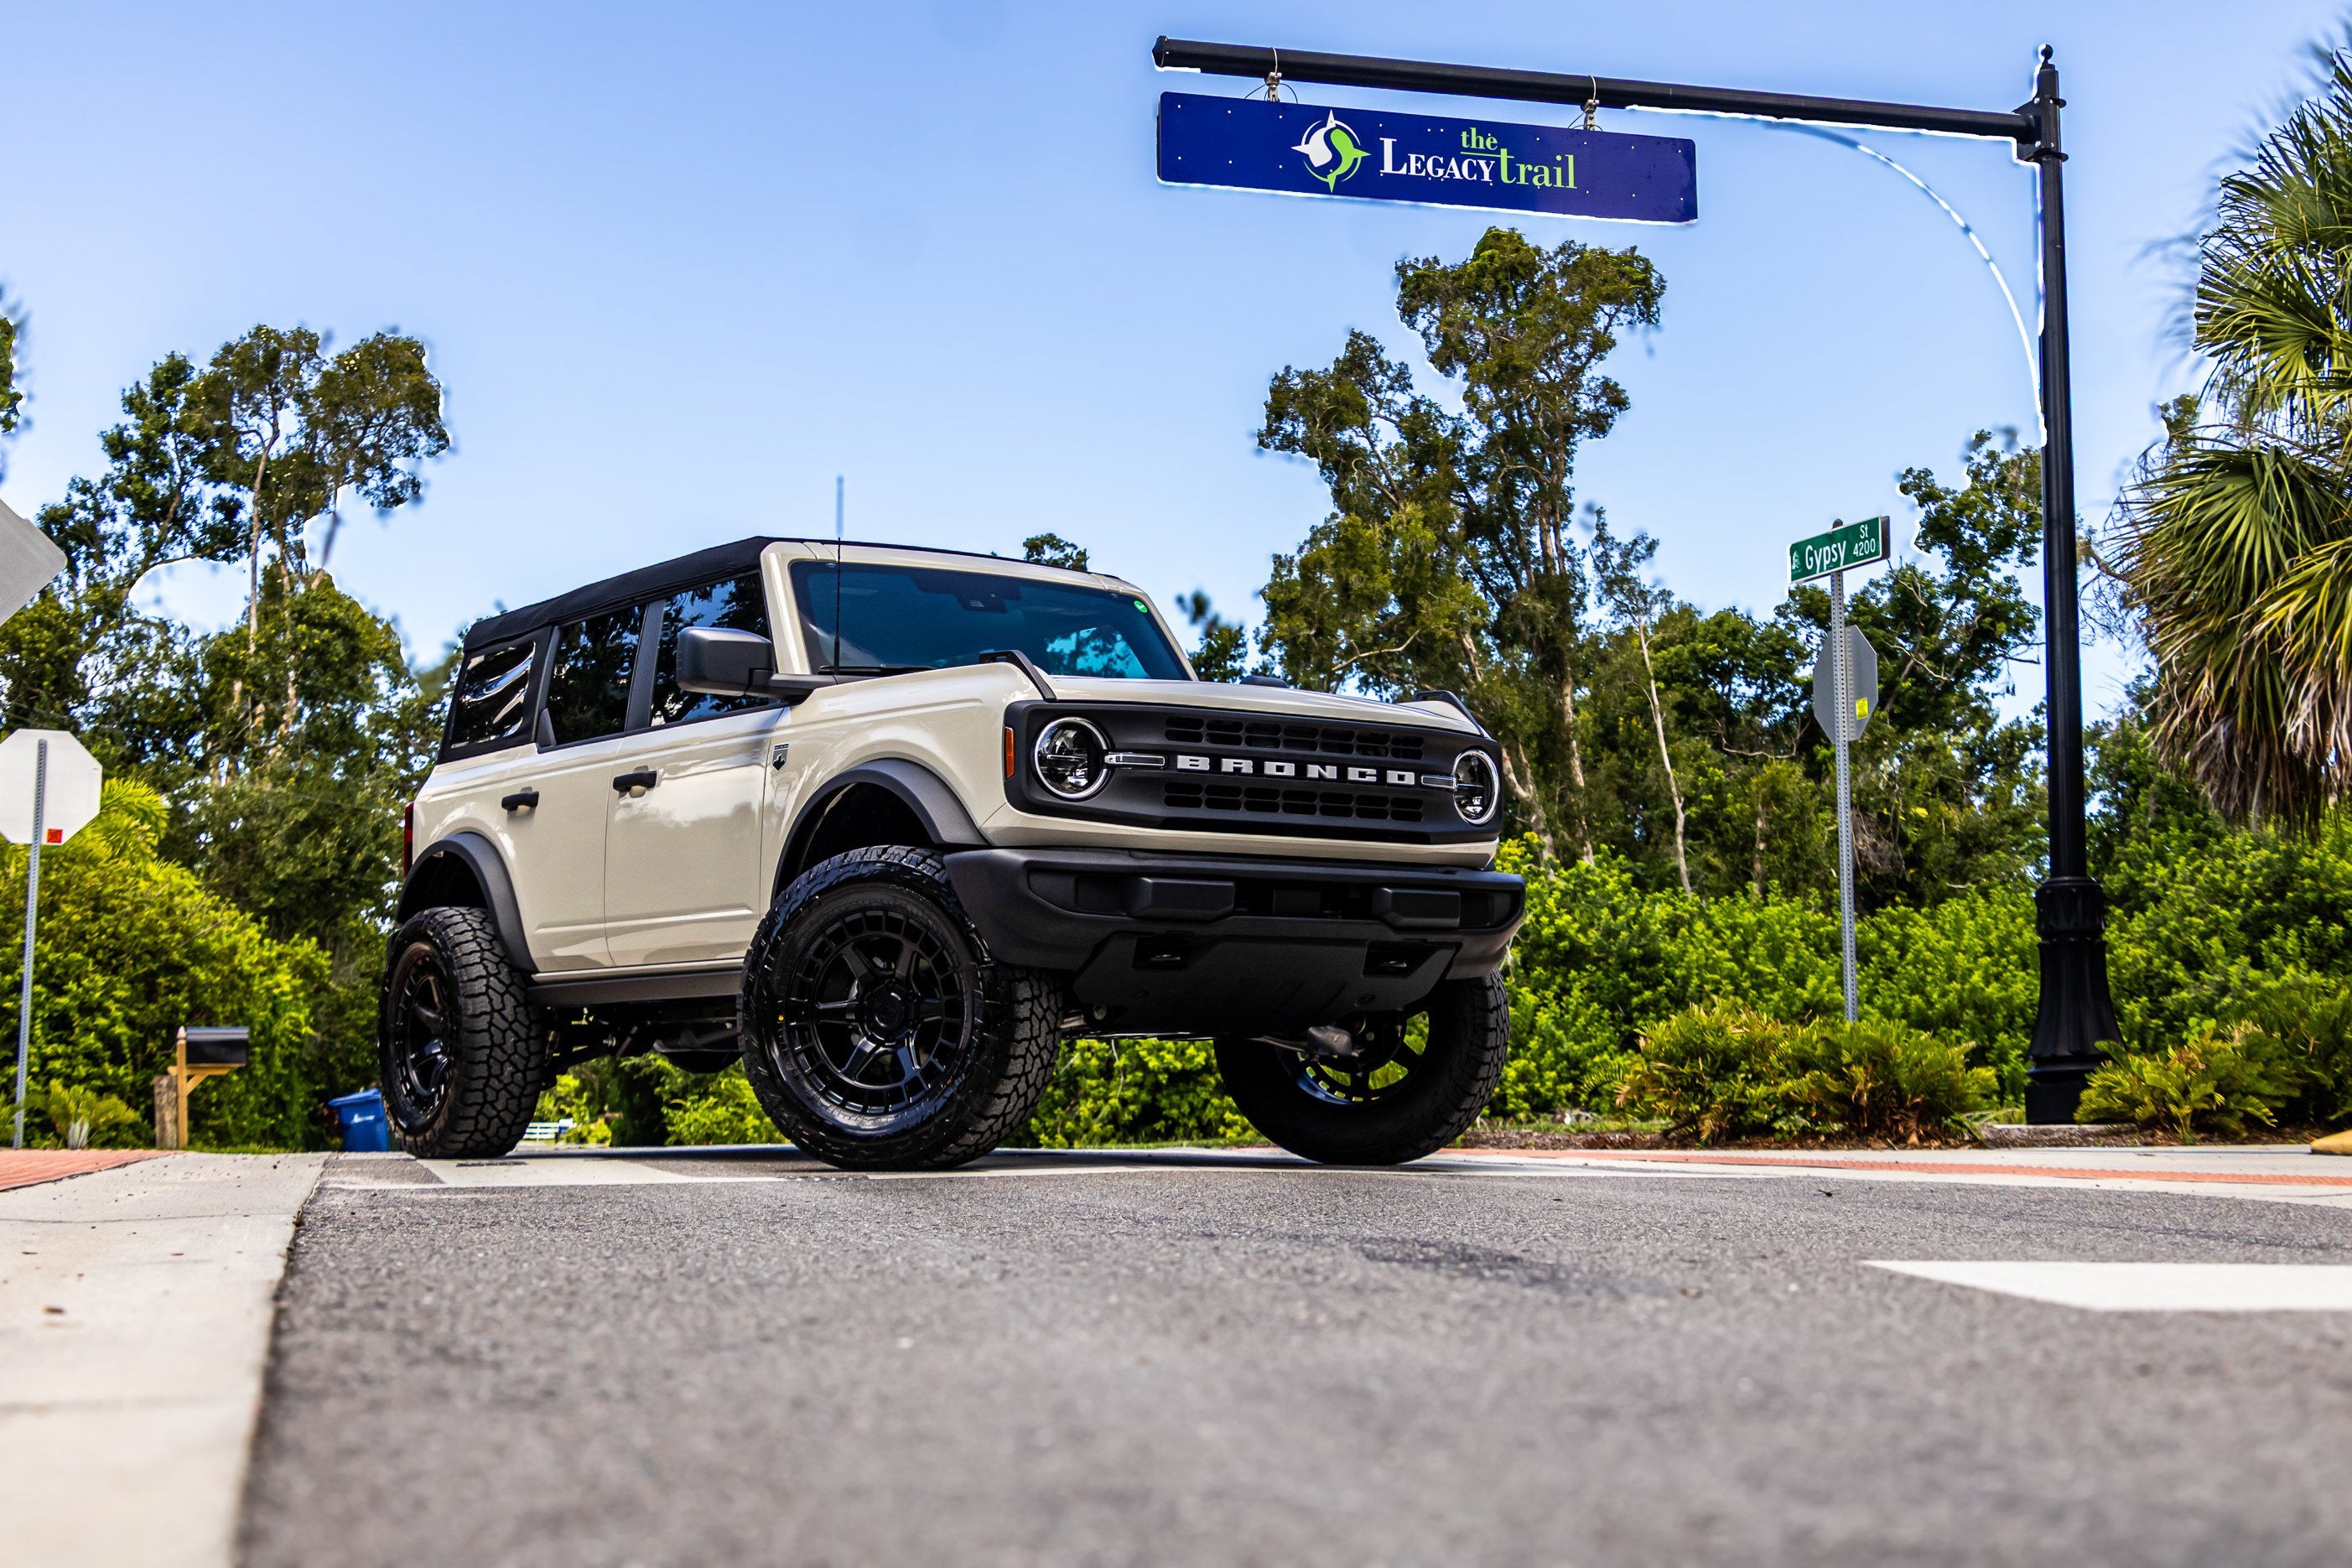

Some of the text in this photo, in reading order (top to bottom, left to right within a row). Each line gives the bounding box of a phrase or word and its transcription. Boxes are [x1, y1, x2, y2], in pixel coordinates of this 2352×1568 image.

[1461, 127, 1498, 150] the
[1379, 137, 1577, 189] LEGACY trail
[1859, 524, 1869, 539] St
[1804, 537, 1876, 574] Gypsy 4200
[1176, 755, 1415, 786] BRONCO
